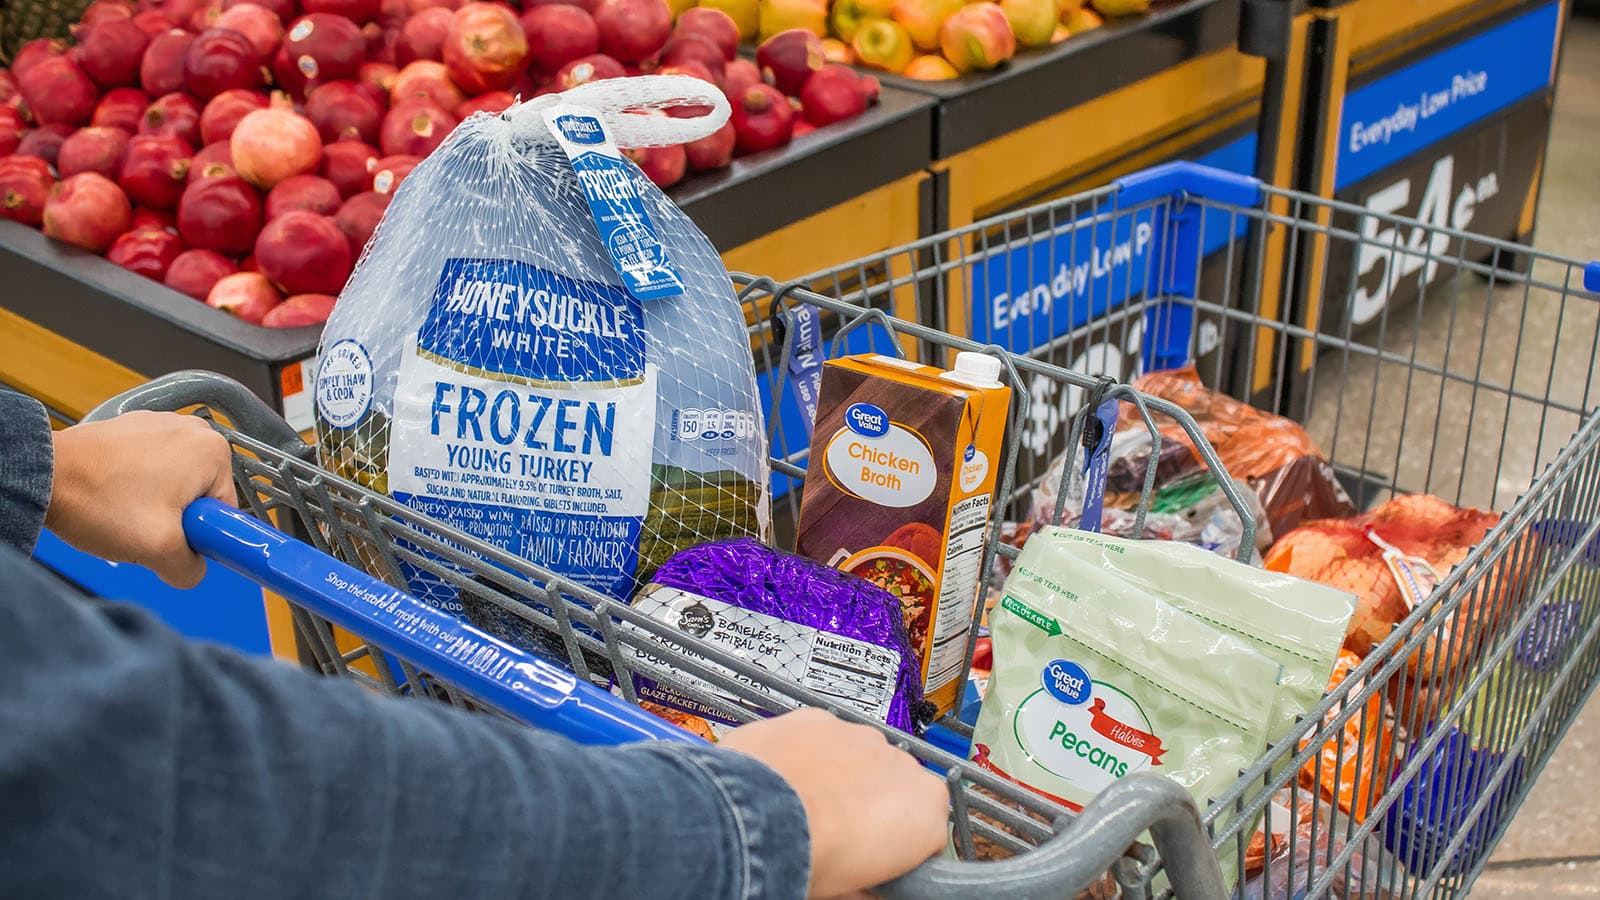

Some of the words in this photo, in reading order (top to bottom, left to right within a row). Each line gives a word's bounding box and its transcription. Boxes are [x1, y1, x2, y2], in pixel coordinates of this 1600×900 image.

[1350, 103, 1419, 153] Everyday
[1421, 90, 1449, 119] Low
[1452, 70, 1488, 103] Price
[446, 276, 631, 341] HONEYSUCKLE
[493, 327, 570, 358] WHITE
[342, 373, 366, 387] THAW
[333, 387, 355, 401] COOK
[430, 381, 617, 457] FROZEN
[683, 420, 698, 433] 150
[851, 406, 882, 426] Great
[858, 418, 881, 433] Value
[446, 443, 511, 475] YOUNG
[519, 453, 593, 483] TURKEY
[847, 441, 920, 475] Chicken
[426, 483, 449, 497] SUGAR
[450, 486, 466, 498] AND
[460, 471, 518, 490] APPROXIMATELY
[549, 483, 576, 497] TURKEY
[860, 465, 902, 491] Broth
[450, 506, 484, 519] RAISED
[488, 511, 514, 522] WITH
[972, 497, 989, 509] Facts
[521, 511, 550, 533] RAISED
[555, 517, 566, 534] BY
[568, 518, 631, 539] INDEPENDENT
[521, 534, 566, 570] FAMILY
[568, 540, 626, 569] FARMERS
[1105, 543, 1126, 554] HERE
[1021, 568, 1035, 580] CUT
[1061, 589, 1080, 603] HERE
[324, 571, 348, 591] Shop
[349, 584, 362, 598] the
[420, 618, 439, 636] with
[1004, 597, 1053, 630] RECLOSABLE
[680, 611, 710, 625] Sam's
[718, 618, 784, 645] BONELESS
[713, 631, 755, 651] SPIRAL
[757, 643, 783, 658] CUT
[815, 637, 861, 656] Nutrition
[864, 649, 891, 664] Facts
[1050, 664, 1085, 692] Great
[1054, 678, 1080, 700] Value
[640, 687, 665, 701] GLAZE
[667, 694, 698, 711] PACKET
[1049, 719, 1129, 779] Pecans
[1110, 724, 1146, 749] Halves
